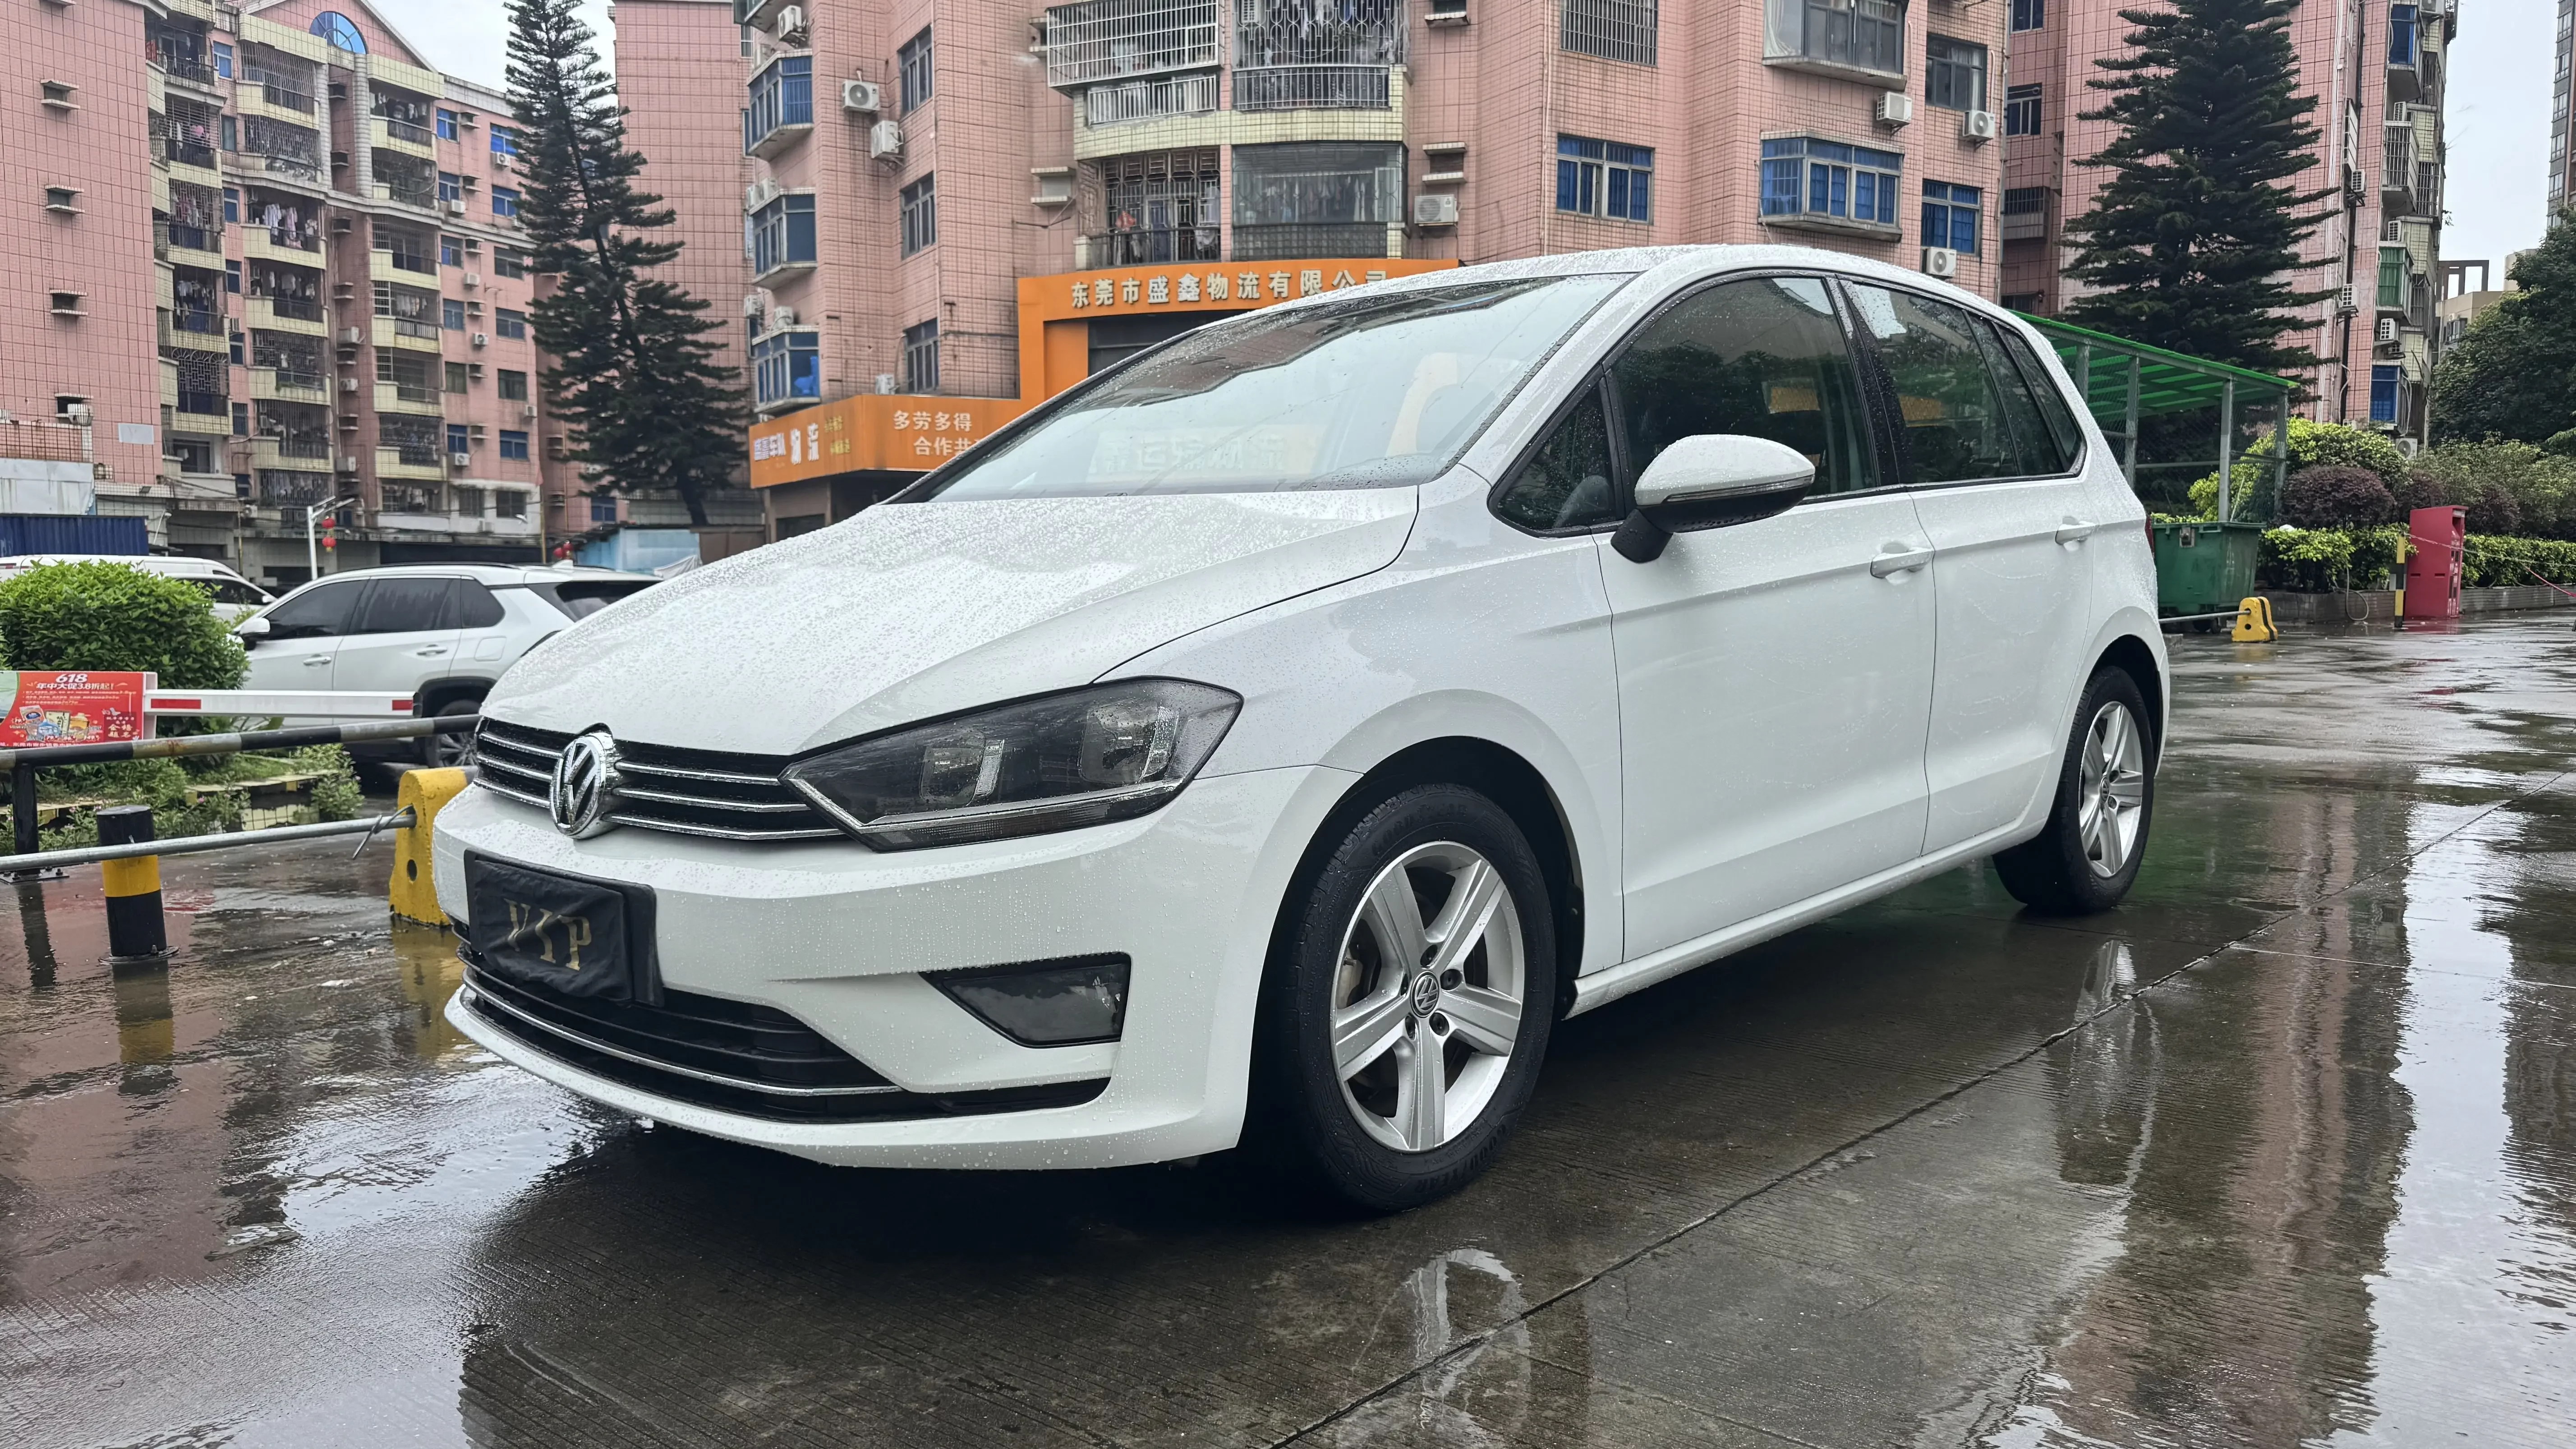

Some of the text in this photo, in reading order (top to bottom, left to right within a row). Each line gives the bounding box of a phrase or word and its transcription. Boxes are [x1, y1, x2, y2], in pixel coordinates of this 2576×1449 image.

[893, 410, 972, 432] 多劳多得
[914, 436, 981, 456] 合作共
[55, 673, 87, 683] 618
[504, 898, 592, 971] VIP
